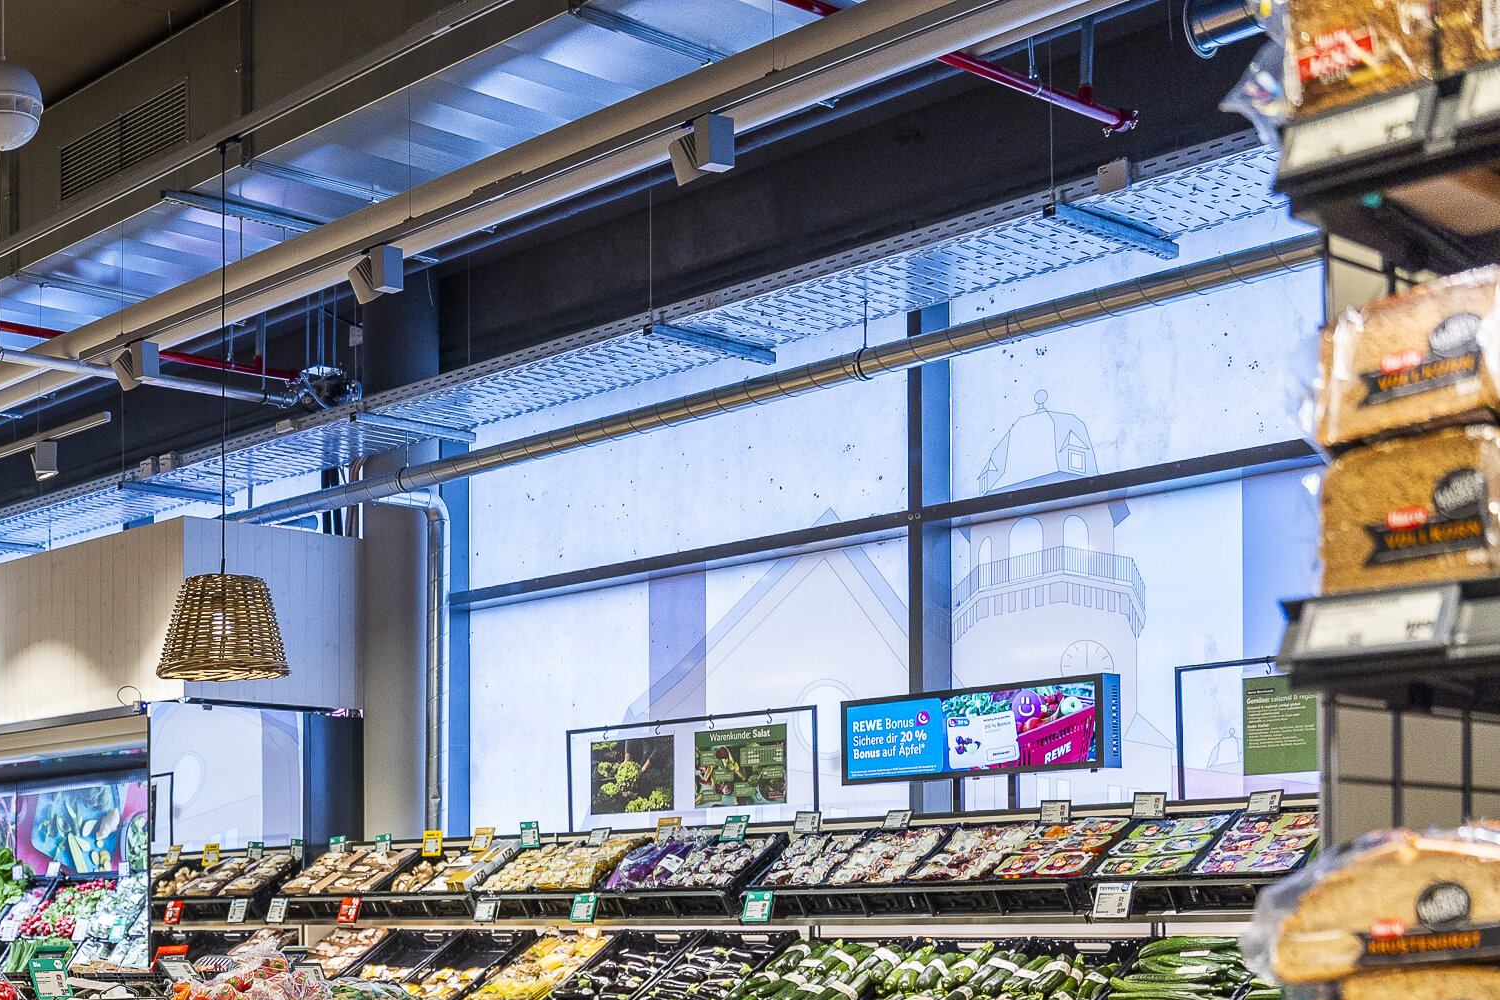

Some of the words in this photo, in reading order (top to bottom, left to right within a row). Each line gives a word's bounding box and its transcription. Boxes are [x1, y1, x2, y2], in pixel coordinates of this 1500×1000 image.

[1271, 694, 1292, 703] saisonal
[1299, 693, 1320, 701] regiona
[852, 719, 883, 733] REWE
[885, 718, 914, 730] Bonus
[710, 732, 751, 742] Warenkunde:
[752, 729, 771, 738] Salat
[853, 735, 884, 747] Sichere
[886, 733, 898, 744] dir
[900, 731, 913, 743] 20
[914, 729, 927, 742] %
[853, 748, 880, 760] Bonus
[882, 745, 897, 758] auf
[1044, 742, 1072, 764] REWE
